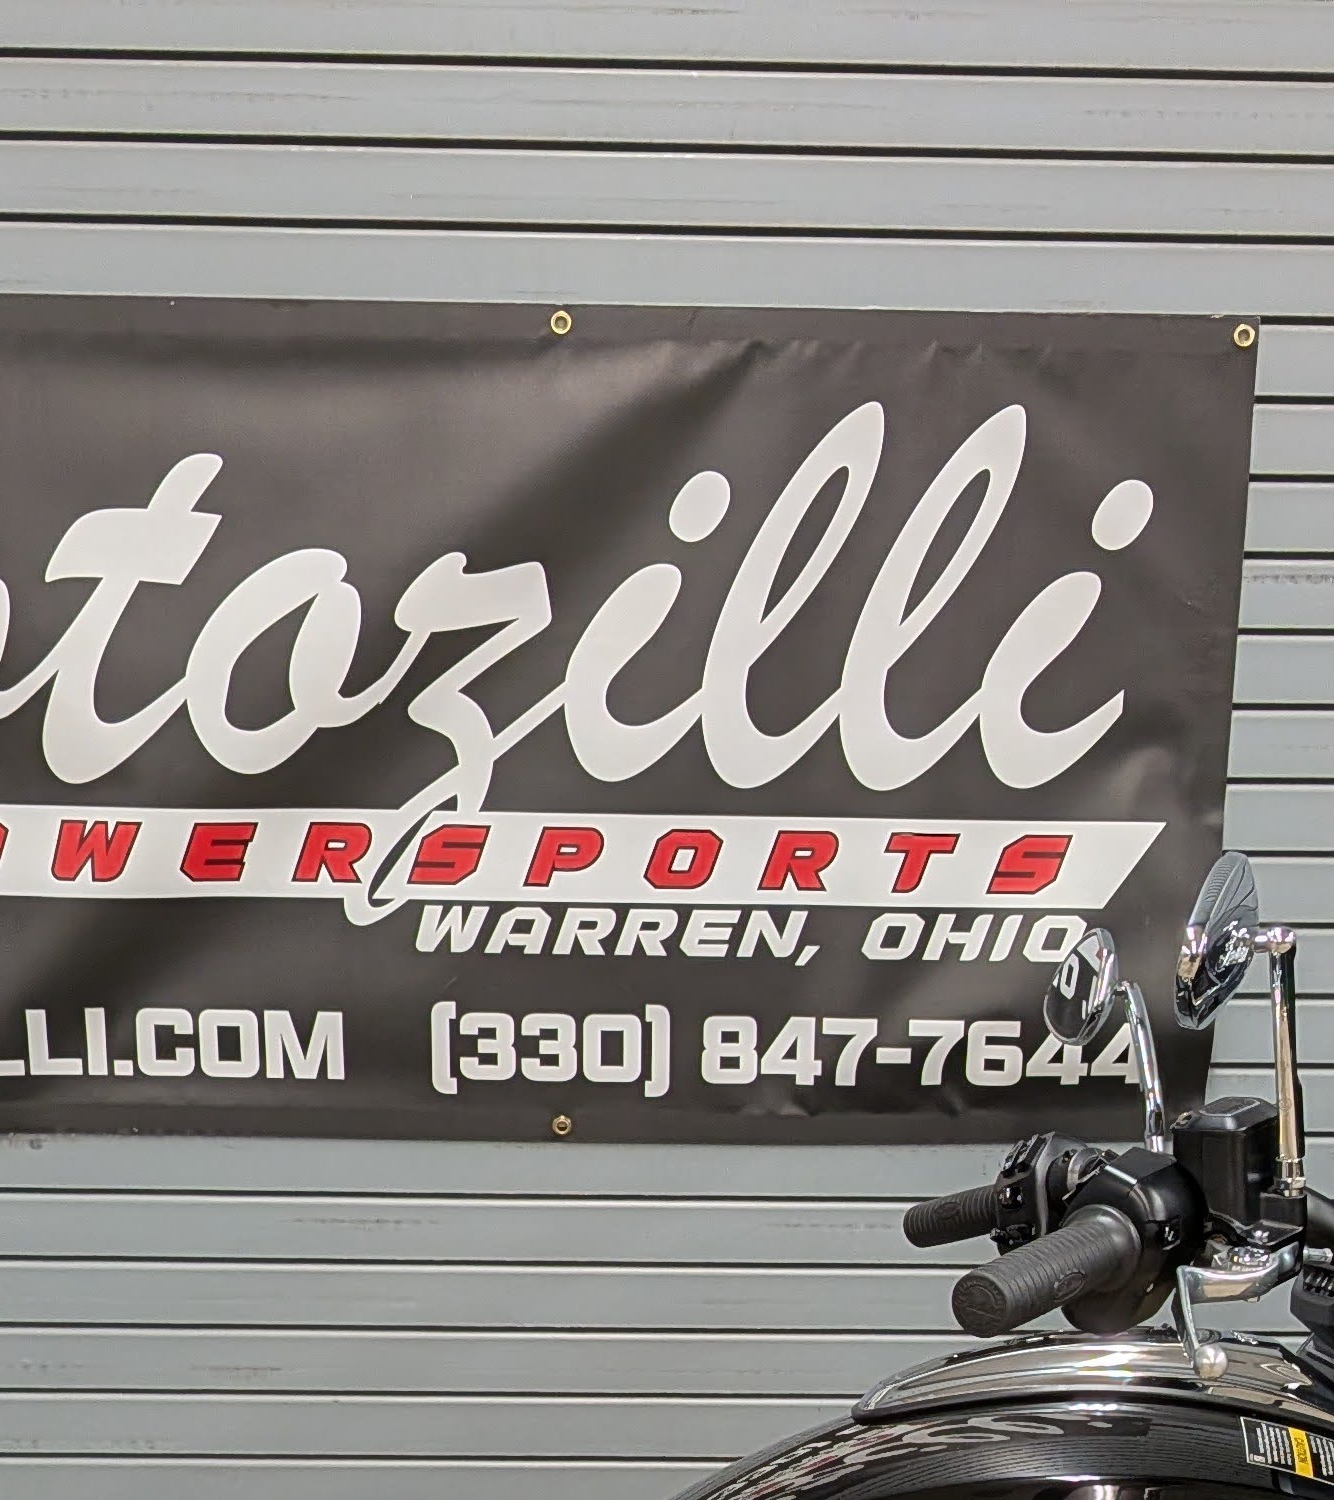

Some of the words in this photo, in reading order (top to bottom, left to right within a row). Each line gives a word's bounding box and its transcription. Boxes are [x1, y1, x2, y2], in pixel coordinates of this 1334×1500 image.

[414, 905, 820, 967] WARREN,
[861, 912, 1088, 963] OHIO
[429, 1000, 669, 1098] (330)
[701, 1016, 1145, 1087] 847-7644
